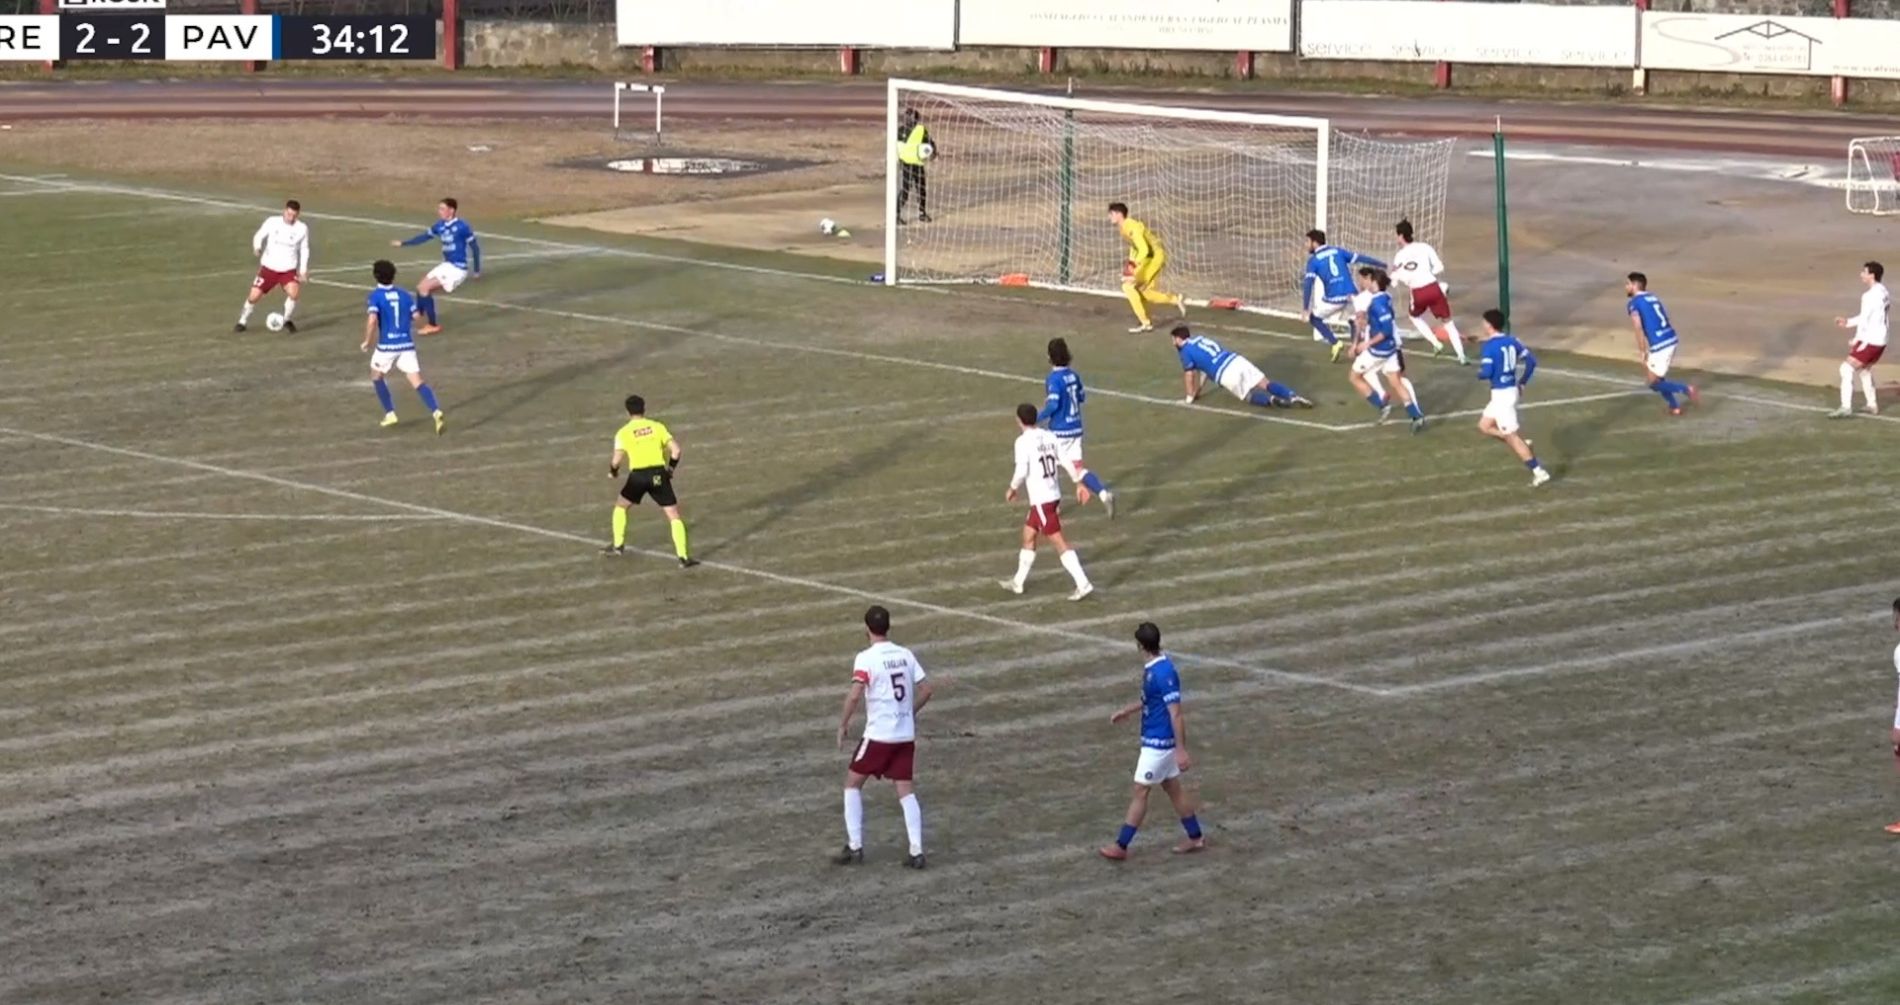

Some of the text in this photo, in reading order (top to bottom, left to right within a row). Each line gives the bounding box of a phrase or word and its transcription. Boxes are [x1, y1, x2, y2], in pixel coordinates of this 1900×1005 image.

[389, 300, 400, 329] 7
[1500, 344, 1517, 373] 10
[1039, 454, 1057, 479] 10
[890, 672, 906, 703] 5
